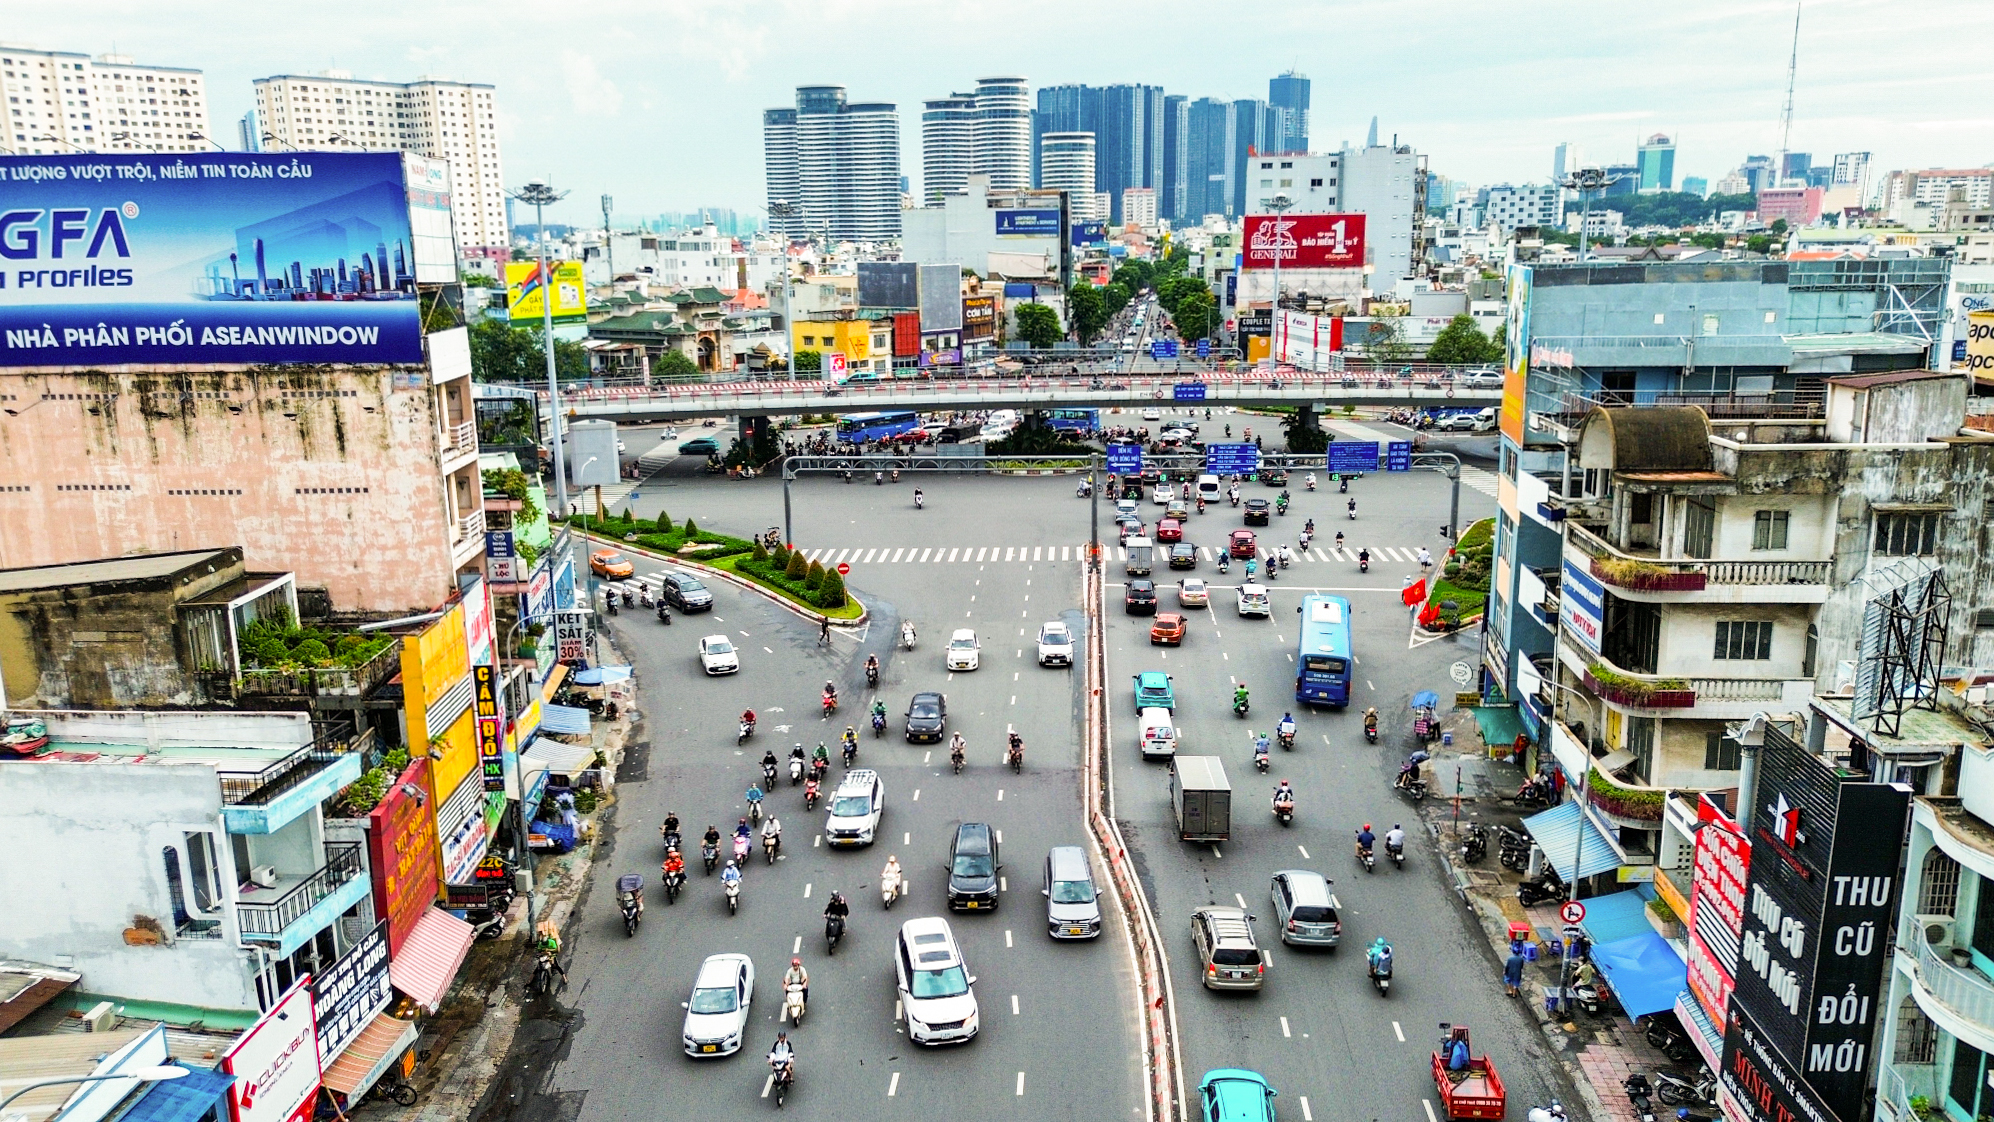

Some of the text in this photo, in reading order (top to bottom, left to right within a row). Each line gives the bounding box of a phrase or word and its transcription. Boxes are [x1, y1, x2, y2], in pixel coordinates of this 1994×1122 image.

[11, 165, 67, 184] LƯỢNG
[70, 164, 114, 182] VƯỢT
[116, 162, 156, 182] TRỘI,
[160, 158, 198, 179] NIỀM
[201, 164, 225, 177] TIN
[229, 162, 273, 178] TOÀN
[277, 159, 312, 178] CẦU
[1250, 249, 1297, 260] GENERALI
[7, 319, 379, 348] NHÀ PHÂN PHỐI ASEANWINDOW
[559, 624, 583, 639] SẮT
[560, 646, 585, 658] 30%
[477, 666, 495, 716] CẦM
[482, 720, 497, 756] ĐỒ
[484, 763, 501, 775] HX
[1721, 845, 1746, 890] CHỮA
[1720, 870, 1745, 918] THOẠ
[1834, 876, 1891, 907] THU
[1752, 882, 1805, 959] THU CŨ
[1835, 921, 1876, 956] CŨ
[314, 939, 387, 1021] HOÀNG LONG
[1743, 930, 1801, 1016] ĐỔI MỚI
[1818, 983, 1869, 1025] ĐỔI
[1753, 1038, 1773, 1070] THỐNG
[1809, 1038, 1866, 1073] MỚI
[1722, 1069, 1737, 1095] ĐIỆN
[1737, 1087, 1755, 1118] THOẠI
[1733, 1047, 1775, 1115] MINH
